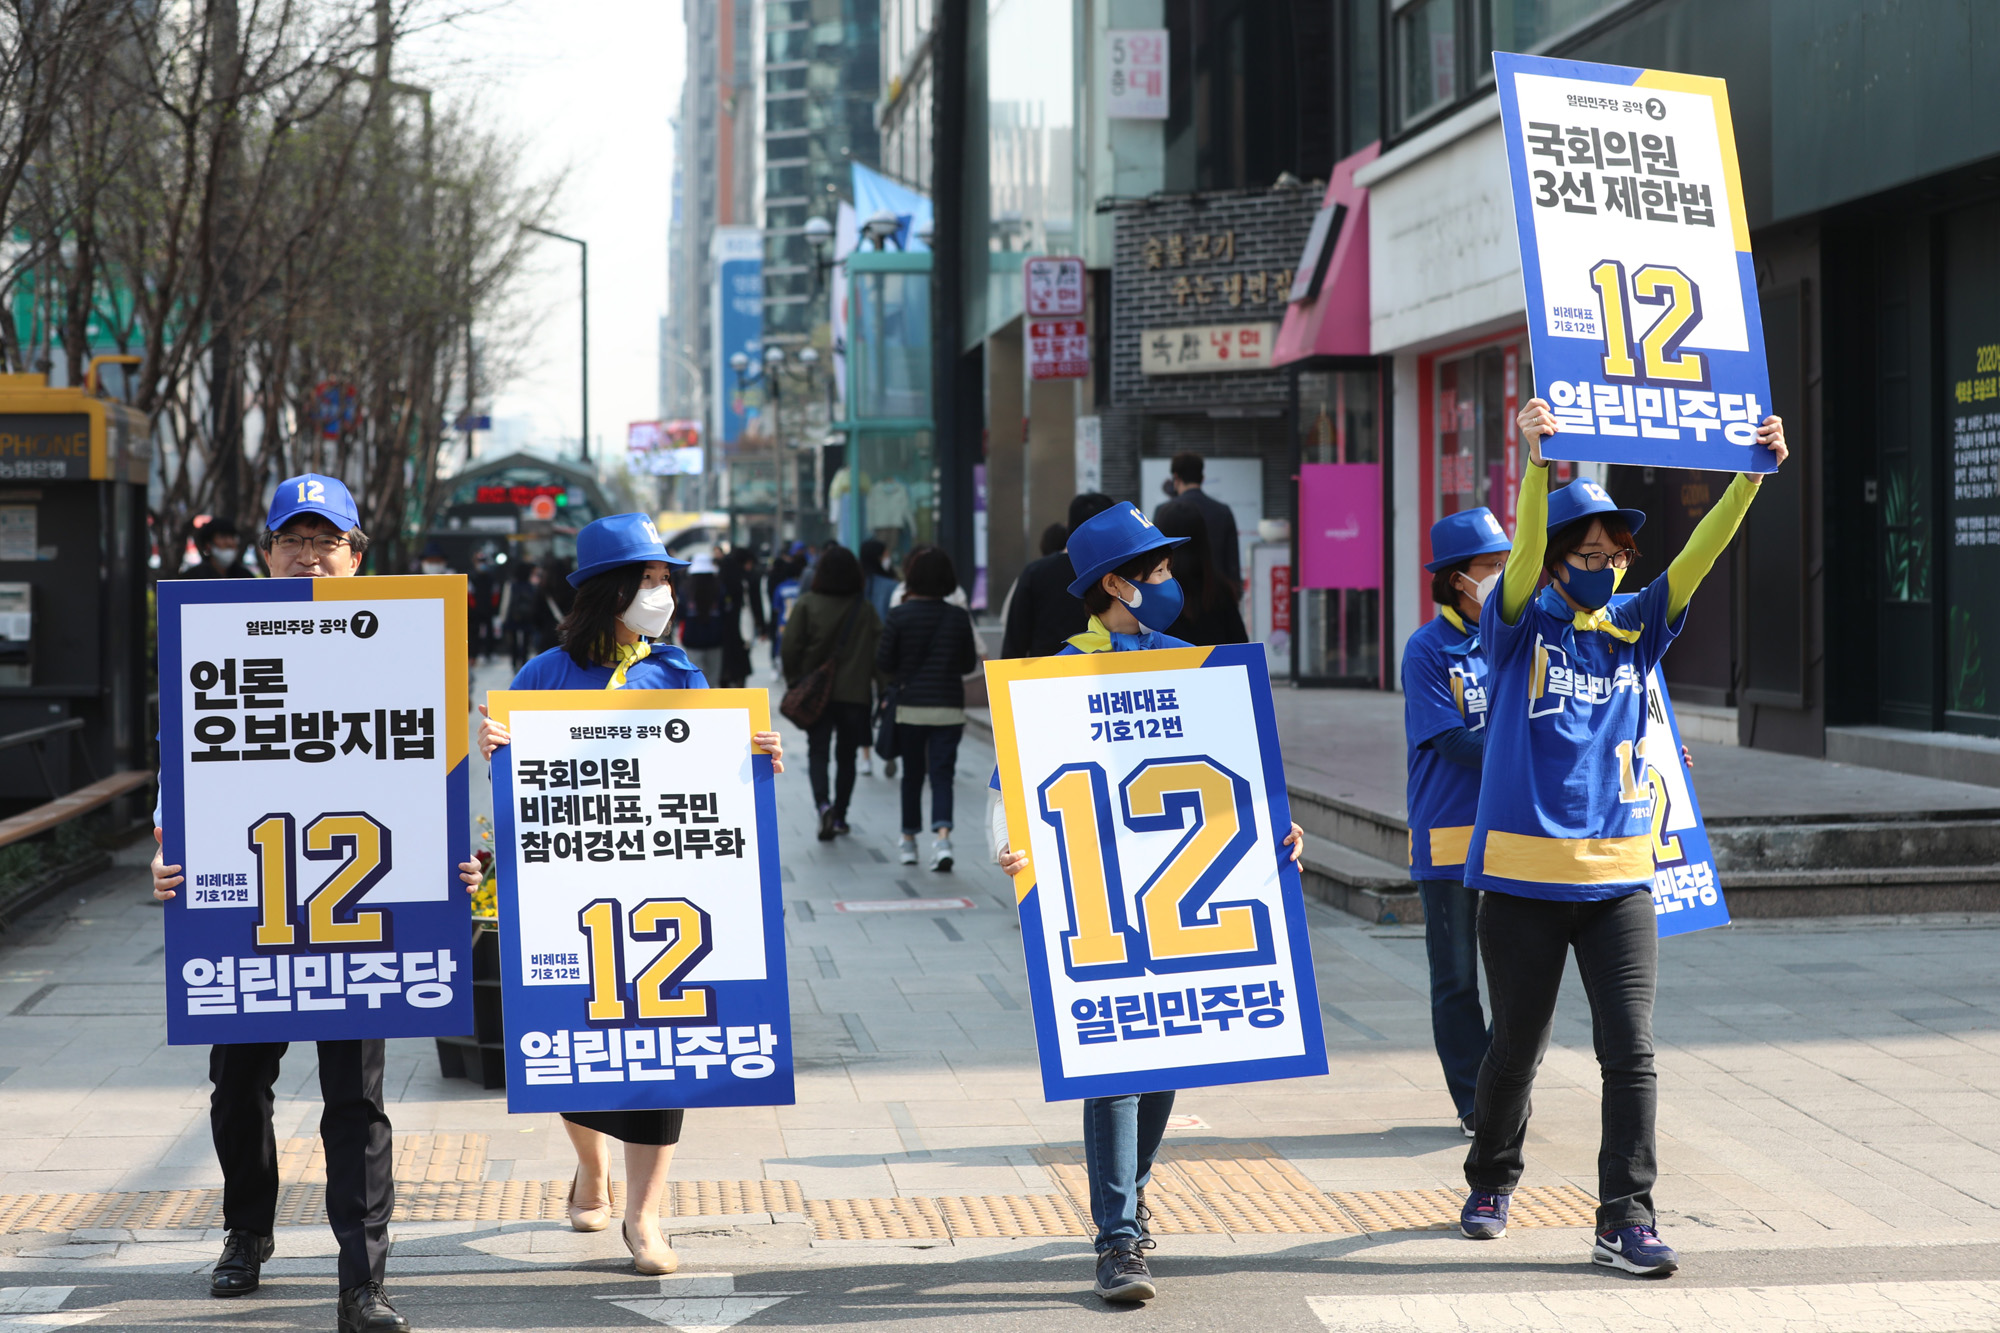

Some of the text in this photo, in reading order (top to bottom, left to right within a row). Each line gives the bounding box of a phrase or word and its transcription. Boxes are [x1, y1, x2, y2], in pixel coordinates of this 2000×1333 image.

[1128, 36, 1162, 98] 임대
[1566, 94, 1619, 112] 열린민주당
[1622, 101, 1643, 115] 공약
[1527, 121, 1680, 178] 국회의원
[1533, 169, 1716, 228] 3선 제한법
[1553, 306, 1594, 321] 비례대표
[1554, 320, 1596, 335] 기호12번
[1588, 258, 1712, 391] 12
[1977, 344, 2000, 373] 2020
[1548, 380, 1762, 447] 열린민주당
[297, 480, 325, 504] 12
[246, 618, 315, 636] 열린민주당
[319, 618, 347, 634] 공약
[189, 658, 288, 710] 언론
[1087, 688, 1179, 715] 비례대표
[1548, 663, 1644, 705] 열린민주당
[191, 708, 435, 763] 오보방지법
[569, 725, 632, 740] 열린민주당
[636, 725, 661, 739] 공약
[1090, 715, 1184, 743] 기호12번
[517, 758, 641, 791] 국회의원
[520, 792, 719, 828] 비례대표, 국민
[1646, 764, 1688, 869] 2
[520, 828, 746, 863] 참여경선 의무화
[196, 873, 248, 888] 비례대표
[247, 811, 393, 955] 12
[1037, 754, 1277, 982] 12
[195, 888, 249, 903] 기호12번
[1652, 860, 1719, 916] 민주당
[530, 953, 580, 966] 비례대표
[530, 967, 581, 981] 기호12번
[577, 897, 718, 1028] 12
[182, 948, 457, 1016] 열린민주당
[1070, 980, 1286, 1046] 열린민주당
[519, 1023, 778, 1086] 열린민주당
